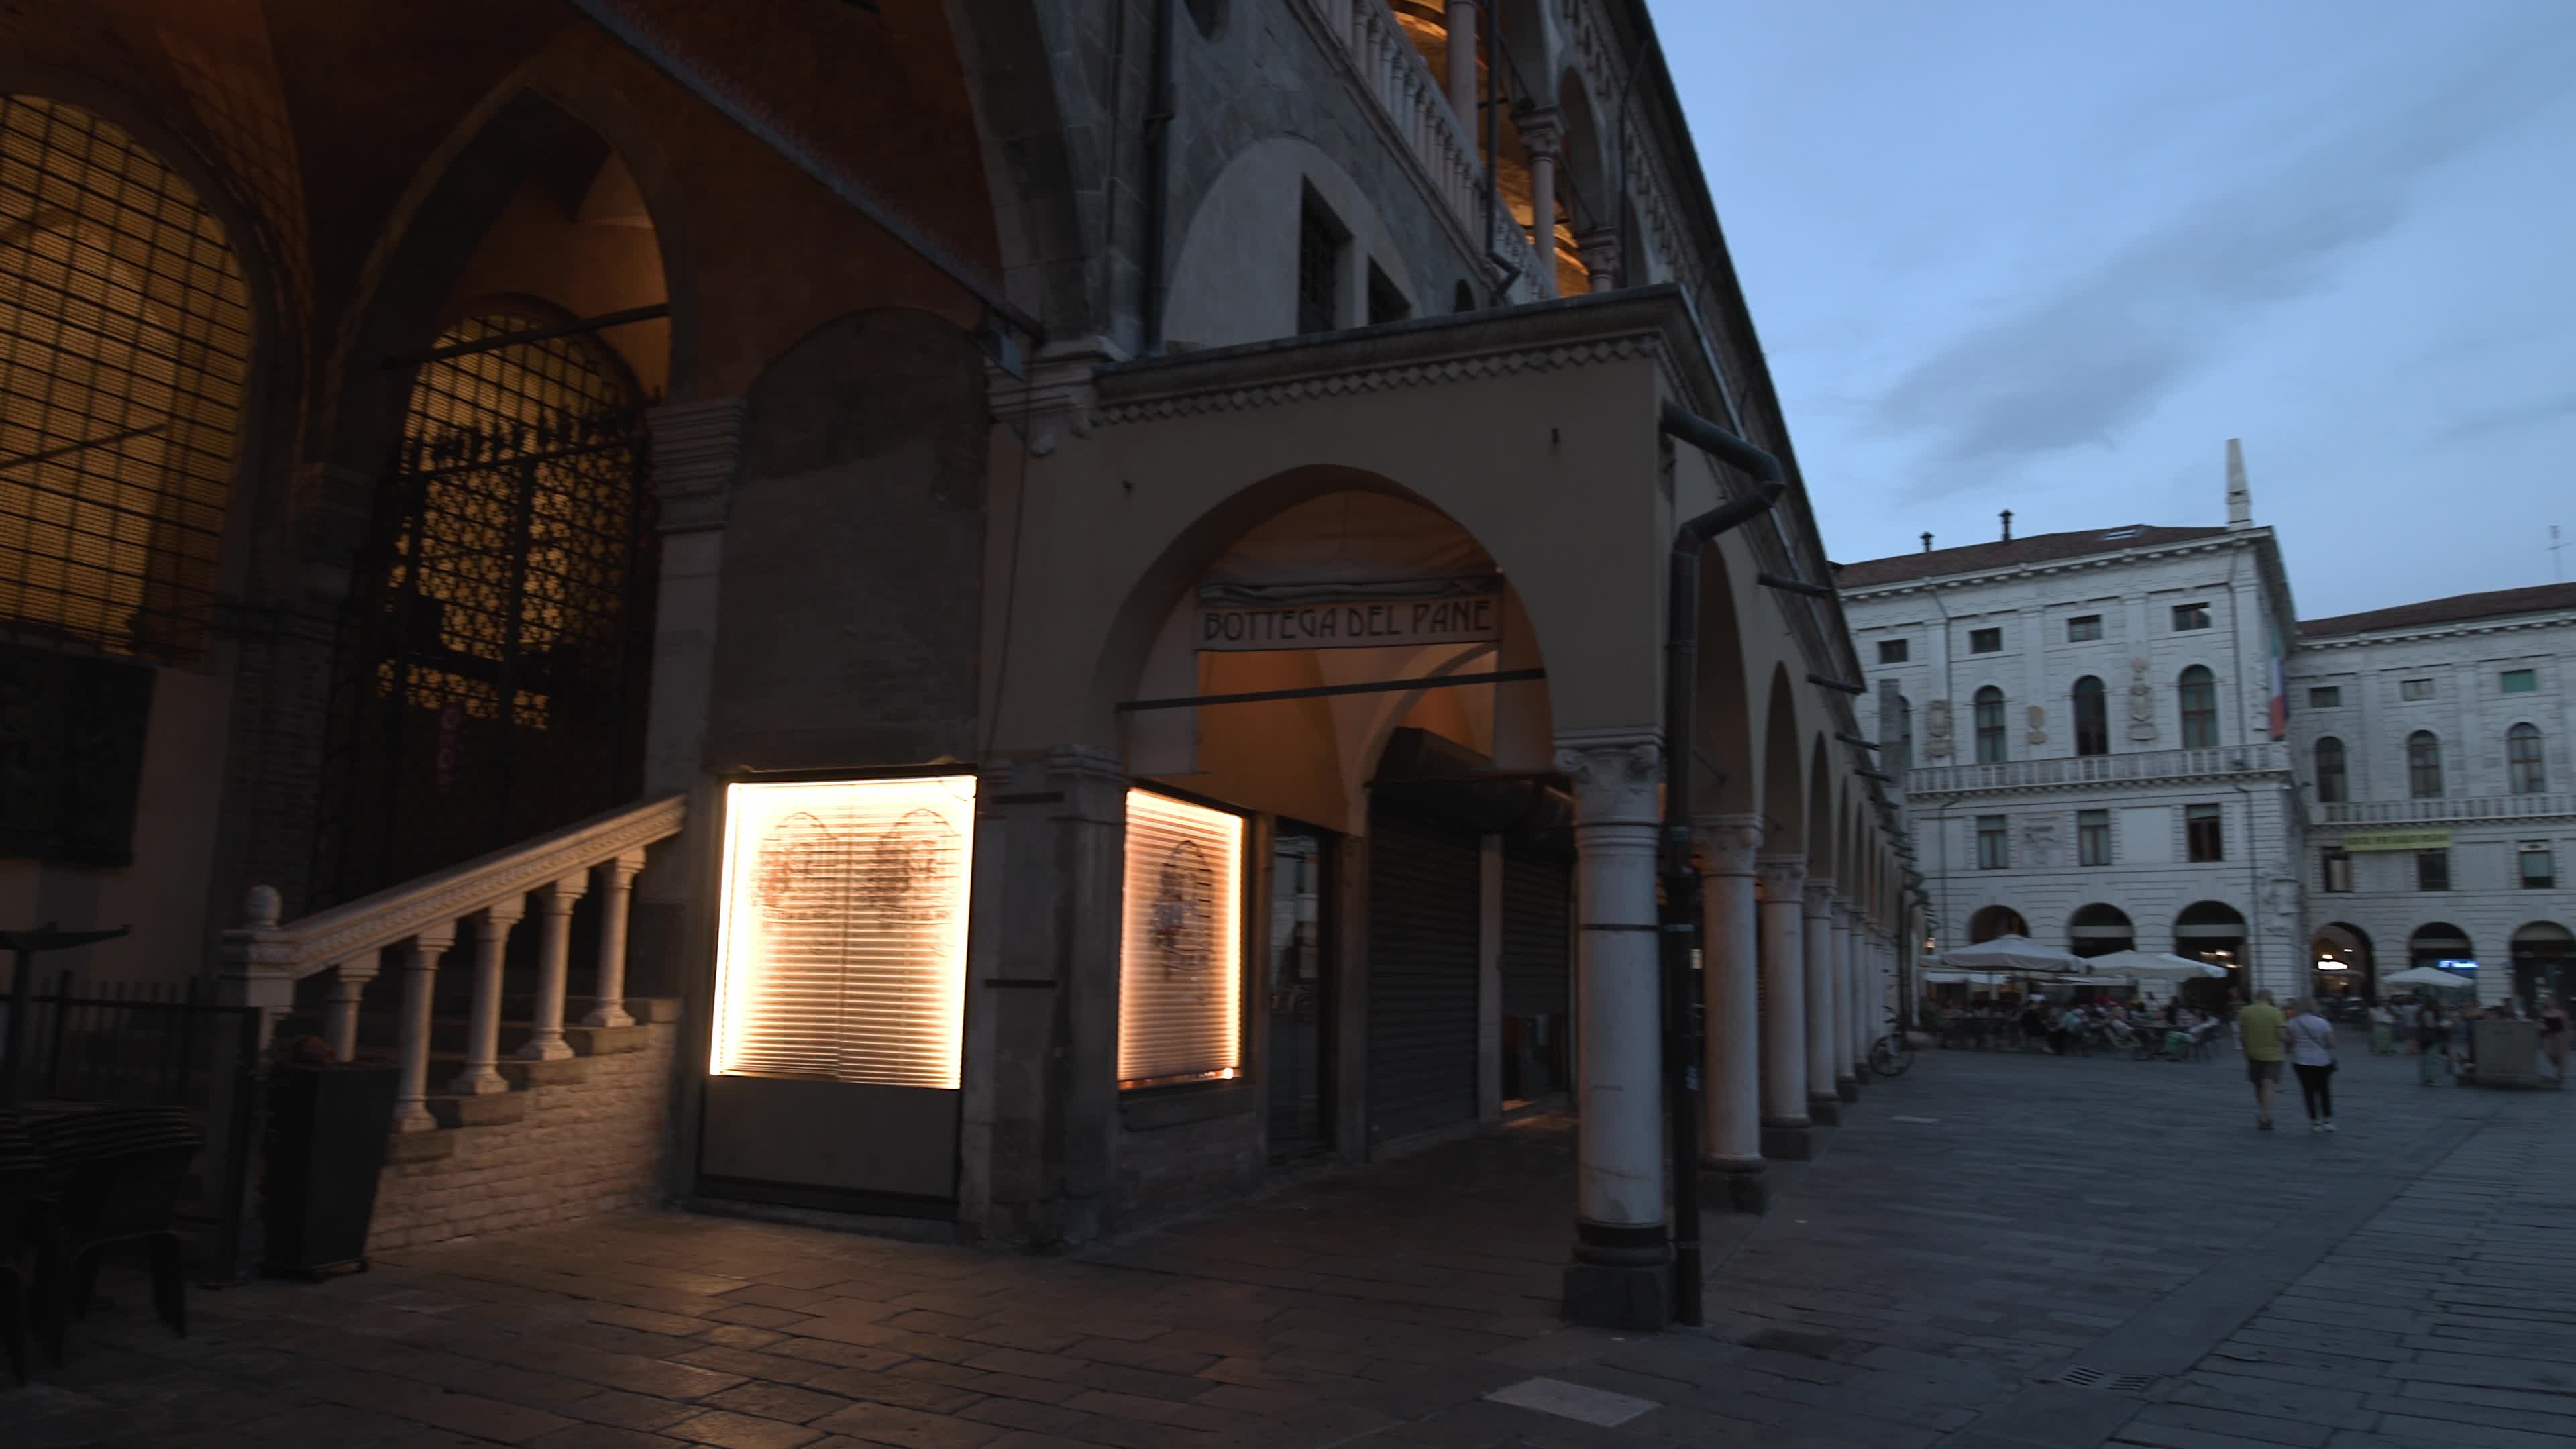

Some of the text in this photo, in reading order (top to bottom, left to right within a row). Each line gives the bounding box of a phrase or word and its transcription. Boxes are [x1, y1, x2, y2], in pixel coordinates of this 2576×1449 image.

[1204, 600, 1492, 641] BOTTEGA DEL PANE
